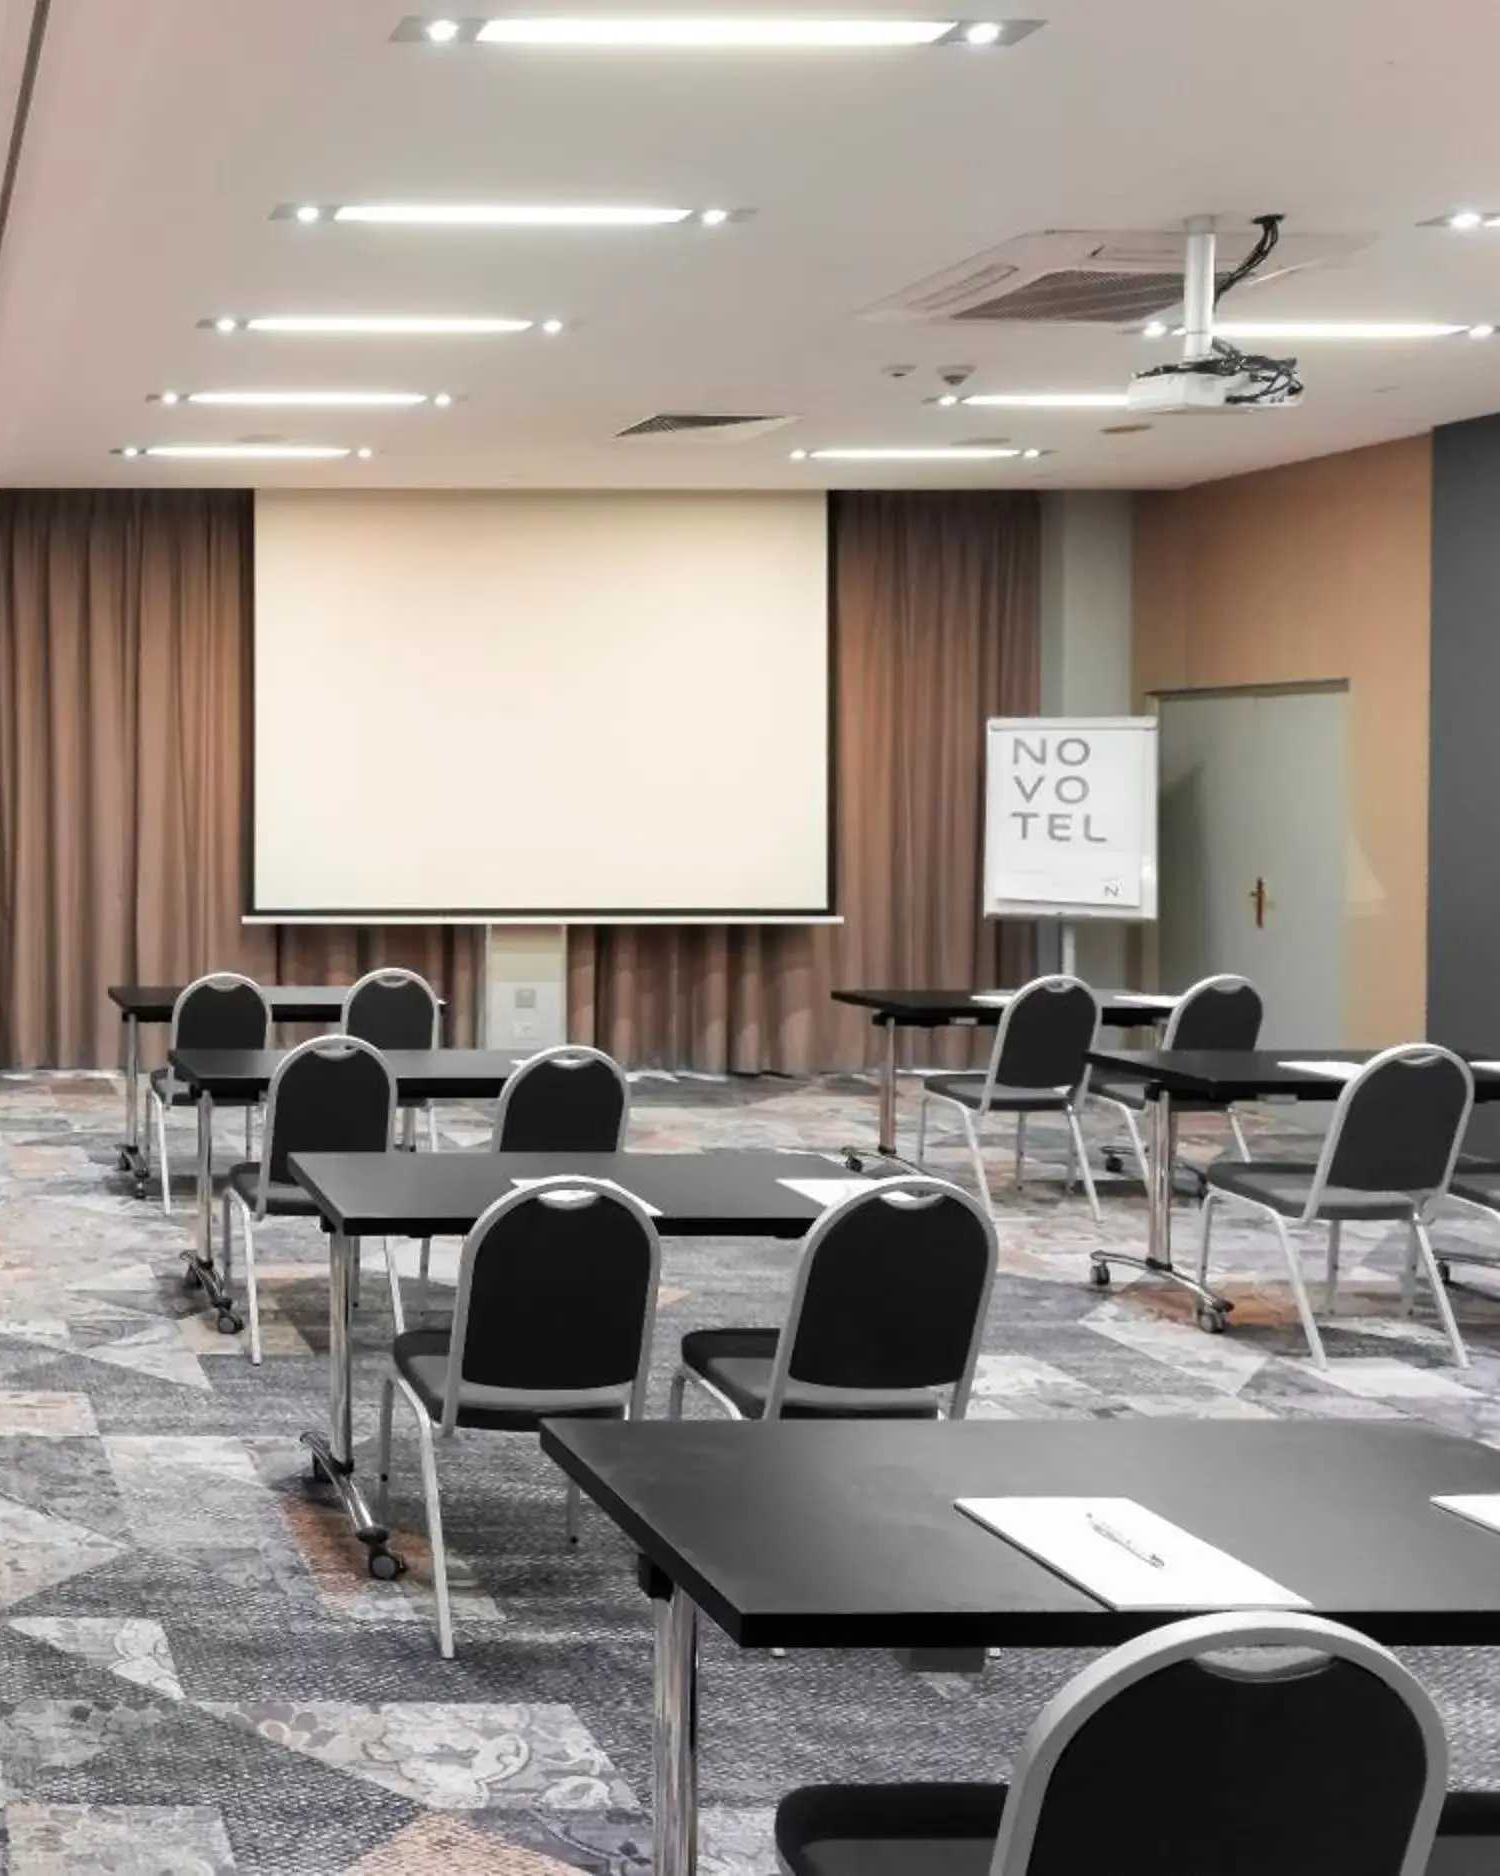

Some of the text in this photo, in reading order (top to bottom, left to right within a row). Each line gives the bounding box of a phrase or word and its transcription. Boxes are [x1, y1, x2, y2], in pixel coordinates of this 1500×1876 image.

[1013, 738, 1091, 766] NO
[1013, 775, 1090, 804] VO
[1010, 811, 1108, 842] TEL
